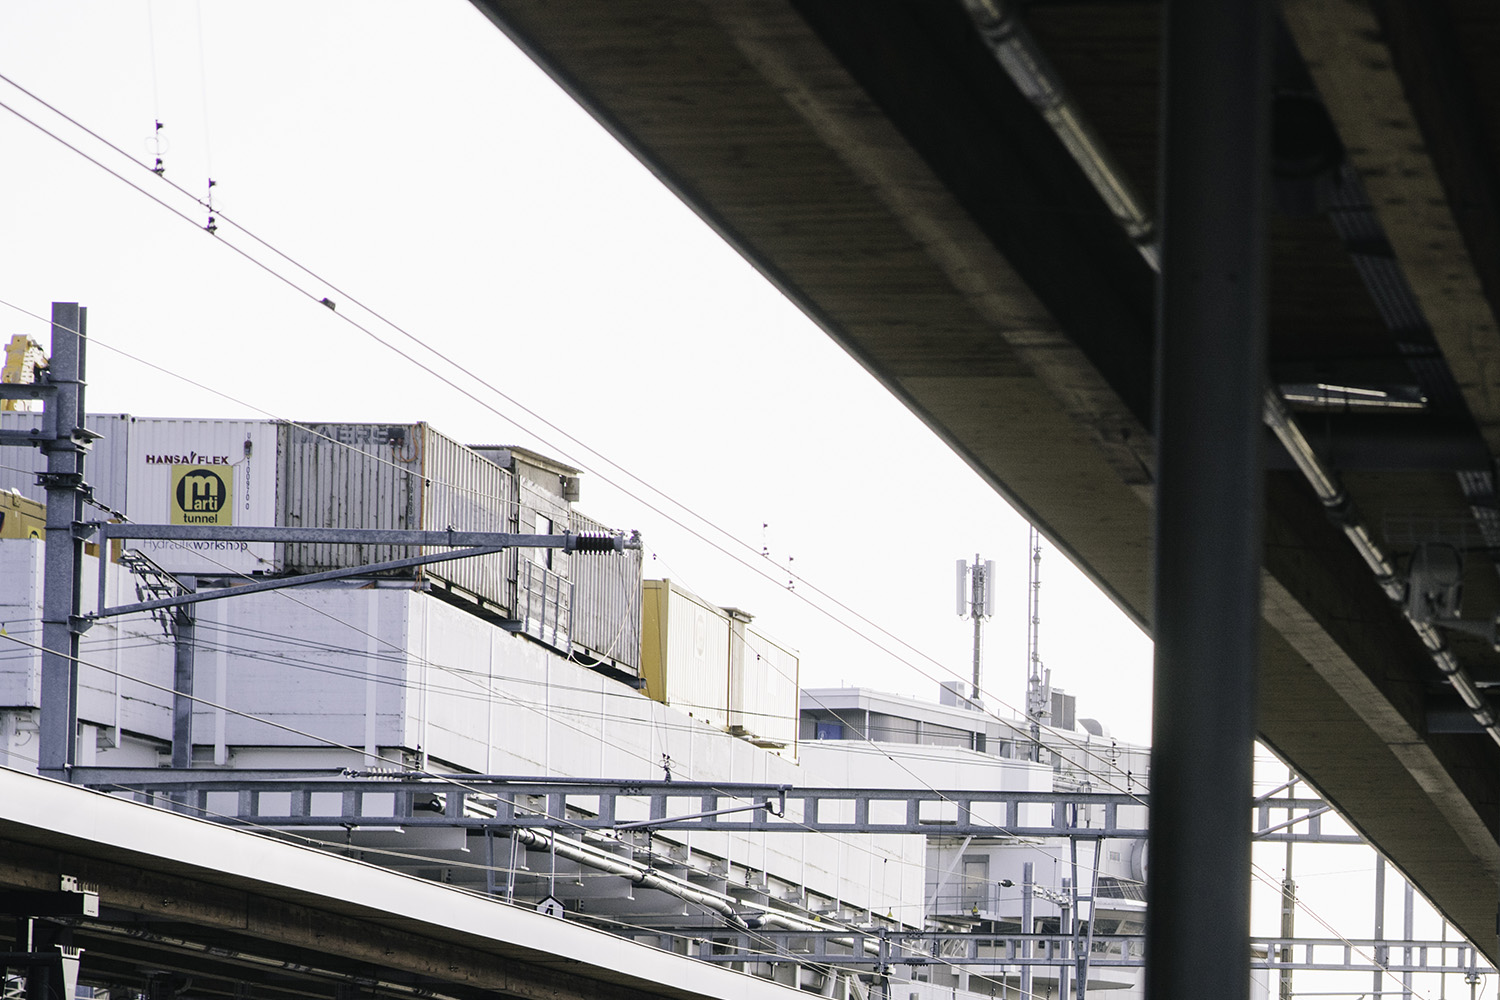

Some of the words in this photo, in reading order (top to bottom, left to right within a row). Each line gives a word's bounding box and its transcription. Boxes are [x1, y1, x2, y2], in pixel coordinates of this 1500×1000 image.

[145, 454, 190, 465] HANSA
[197, 455, 229, 465] FLEX
[183, 513, 218, 524] tunnel
